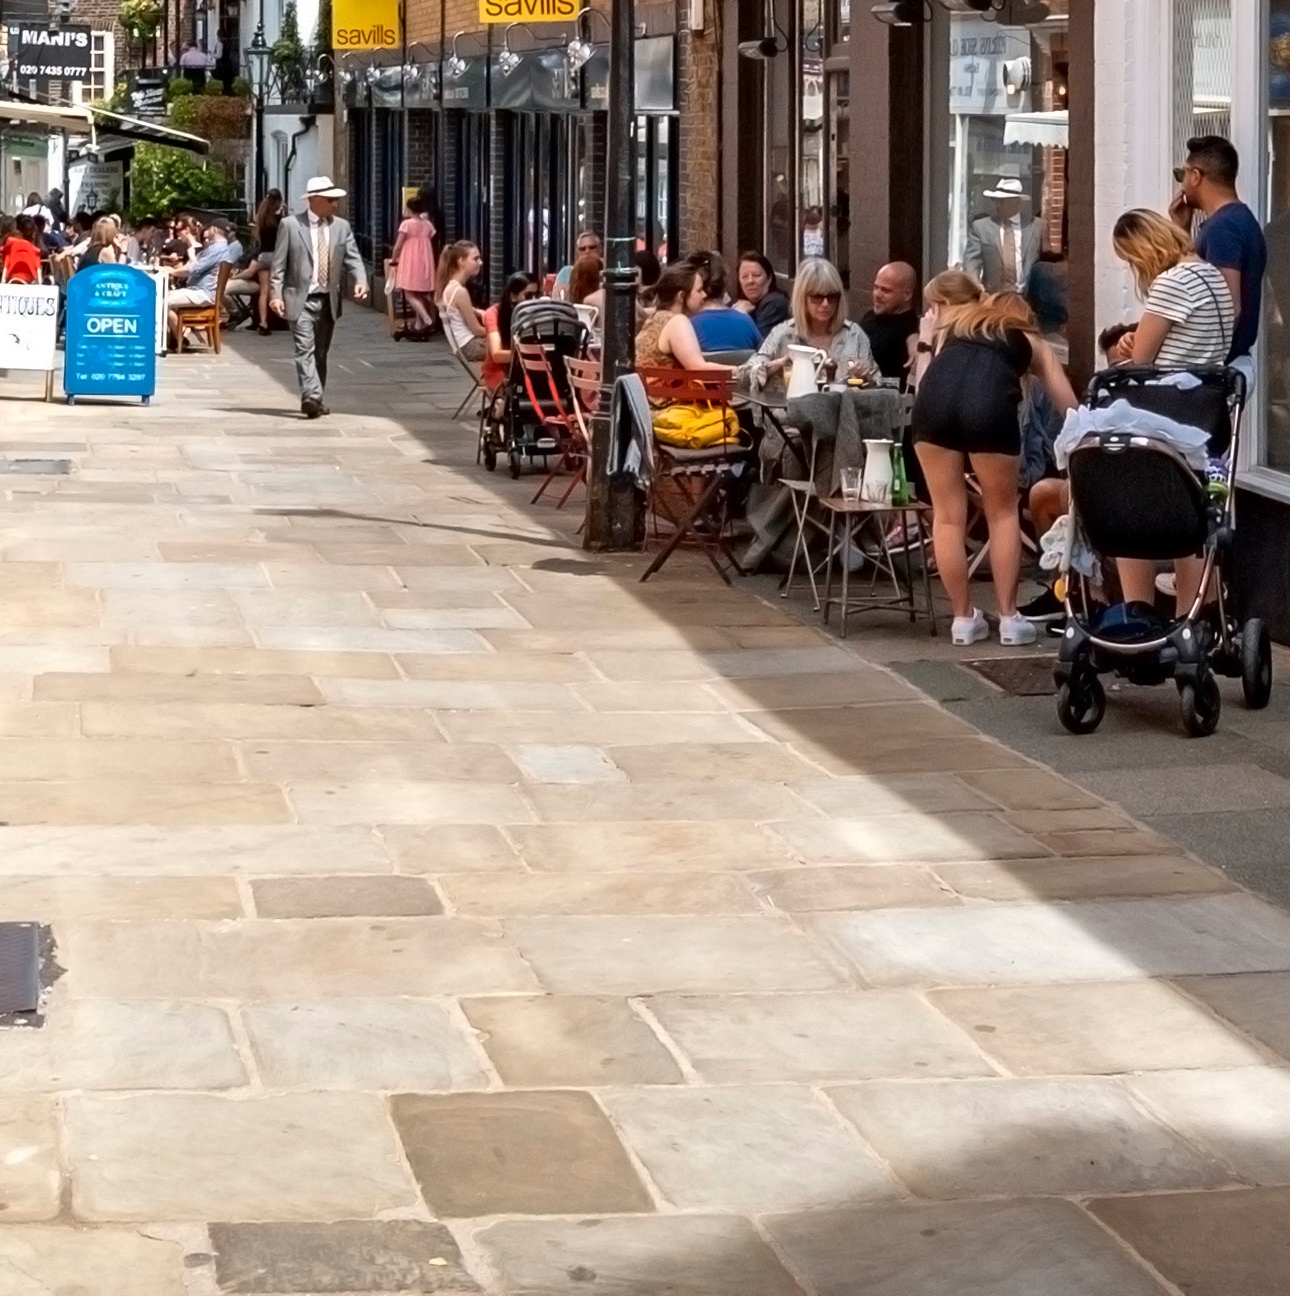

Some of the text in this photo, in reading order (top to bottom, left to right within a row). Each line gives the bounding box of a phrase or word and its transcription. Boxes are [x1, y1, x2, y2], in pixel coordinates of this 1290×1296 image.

[21, 30, 88, 47] MANI'S
[336, 24, 396, 46] savills
[19, 65, 87, 77] 020 7435 0777
[86, 317, 138, 334] OPEN
